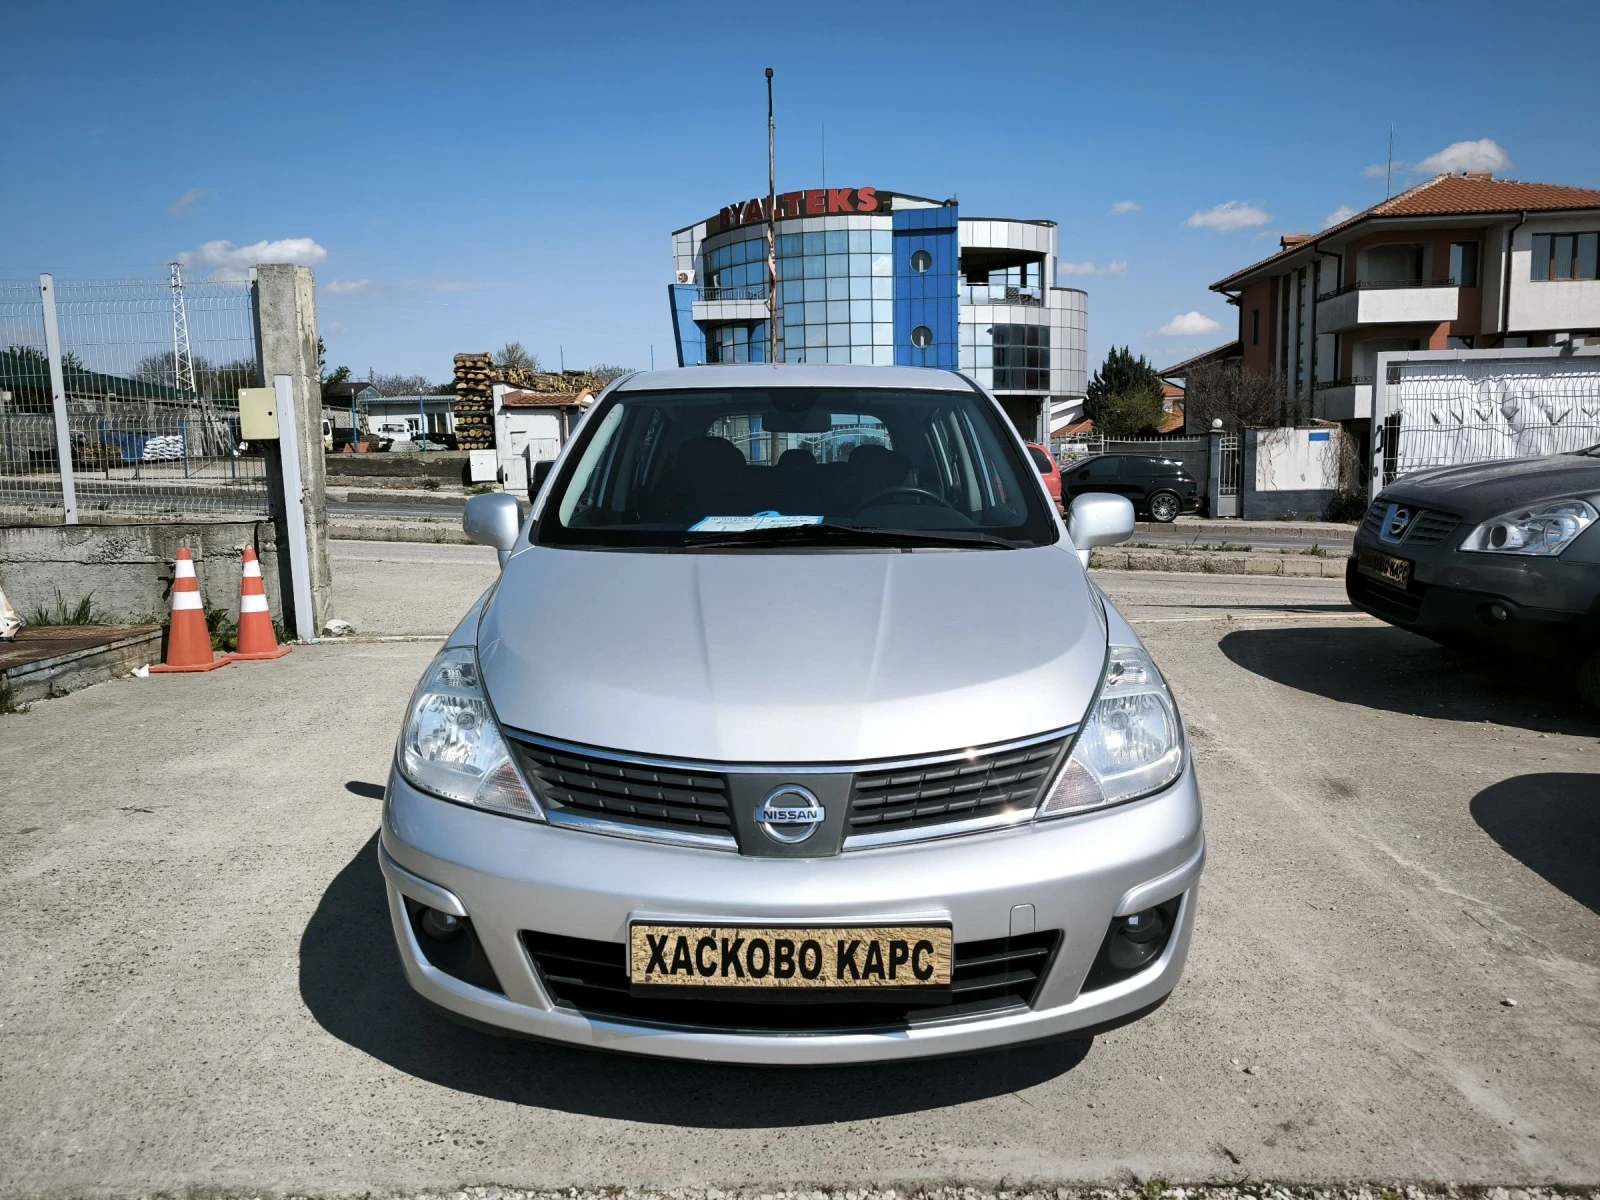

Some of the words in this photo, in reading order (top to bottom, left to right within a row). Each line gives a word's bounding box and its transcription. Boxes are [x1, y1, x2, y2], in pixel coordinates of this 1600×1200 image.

[720, 187, 878, 229] BYALTEKS
[763, 809, 818, 820] NISSAN
[645, 934, 823, 979] ХАСКОВО
[837, 939, 934, 981] КАРС
